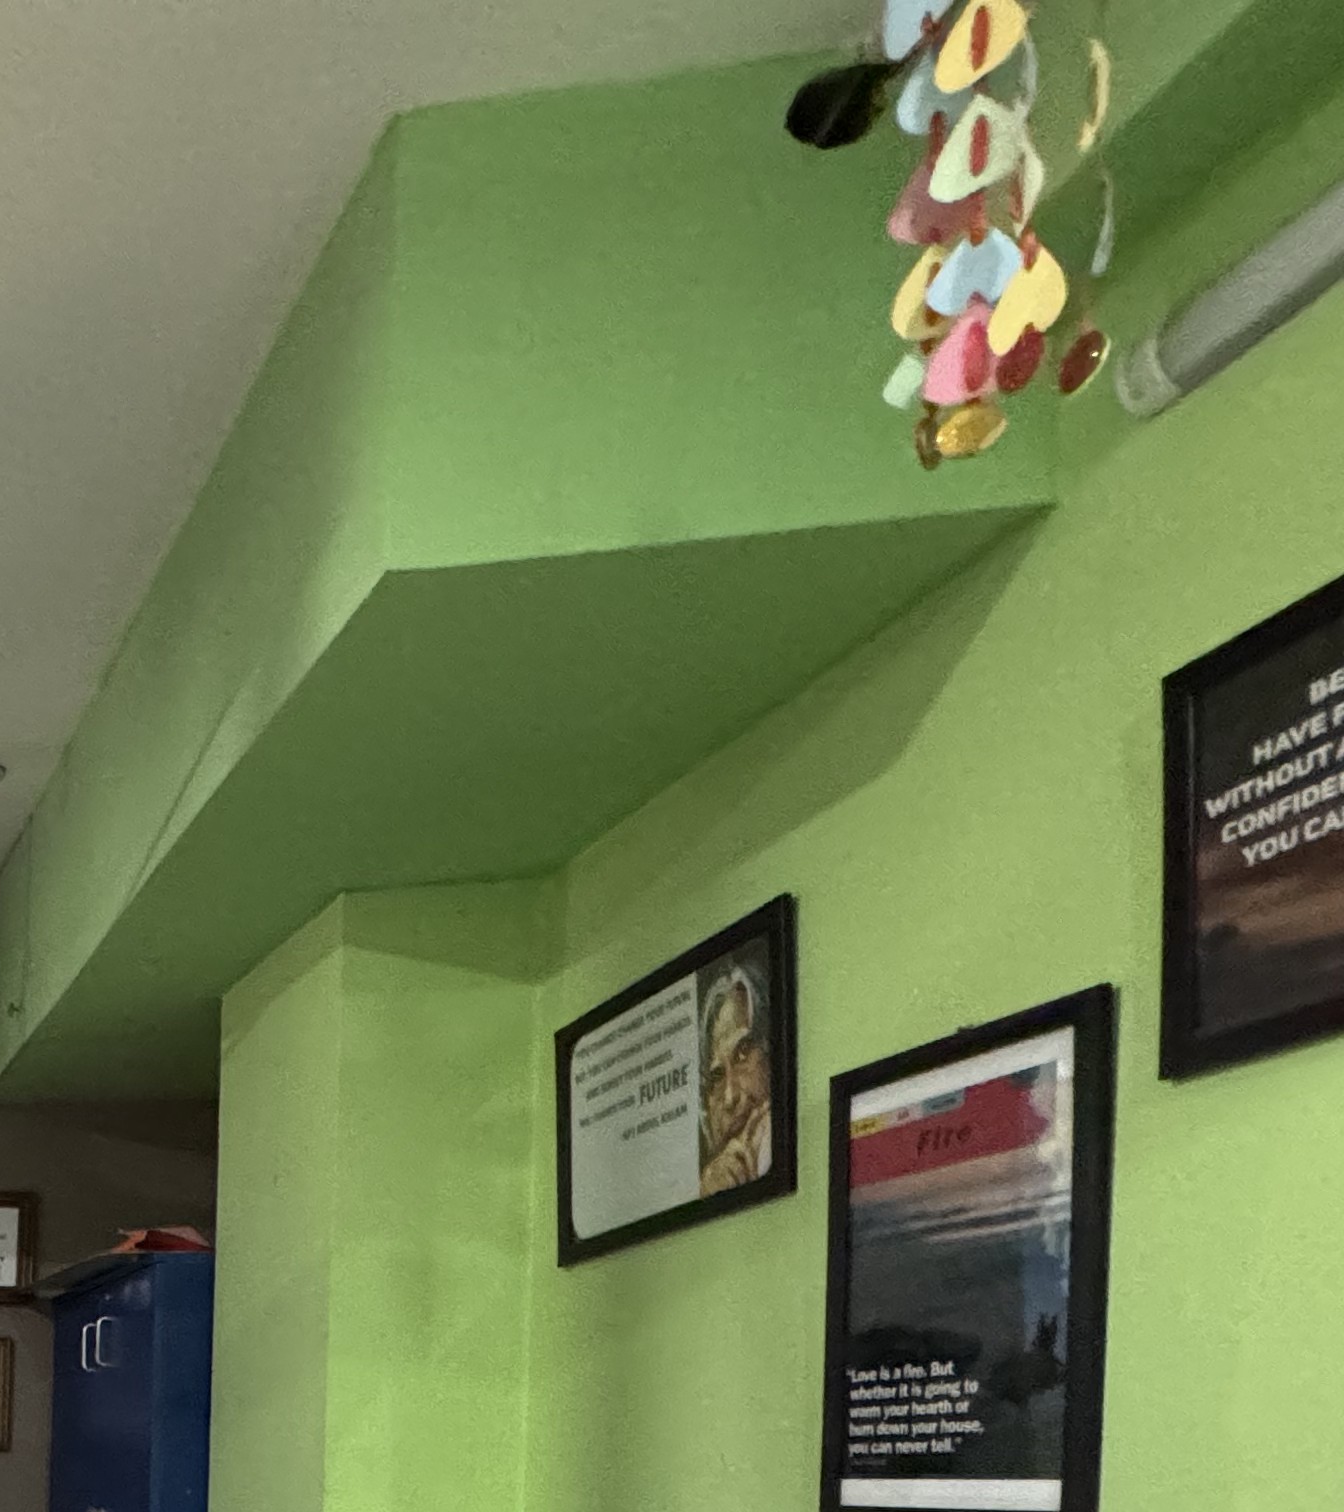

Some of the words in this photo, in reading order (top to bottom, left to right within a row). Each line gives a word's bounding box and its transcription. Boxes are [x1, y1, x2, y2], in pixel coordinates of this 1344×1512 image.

[1253, 711, 1327, 765] HAVE
[1205, 742, 1334, 819] WITHOUT
[1222, 769, 1344, 843] CONFIDE
[1242, 825, 1299, 867] YOU
[1303, 806, 1344, 841] CA
[639, 1064, 689, 1107] FUTURE
[916, 1125, 973, 1158] Fire
[879, 1365, 890, 1381] is
[930, 1360, 955, 1377] But
[849, 1385, 897, 1401] whether
[898, 1383, 909, 1398] it
[911, 1382, 922, 1398] is
[924, 1380, 962, 1400] going
[963, 1378, 979, 1394] to
[883, 1404, 910, 1420] your
[911, 1400, 953, 1416] hearth
[876, 1421, 909, 1436] down
[911, 1422, 938, 1439] your
[940, 1418, 985, 1436] house,
[848, 1442, 869, 1458] you
[870, 1441, 893, 1455] can
[895, 1441, 929, 1455] never
